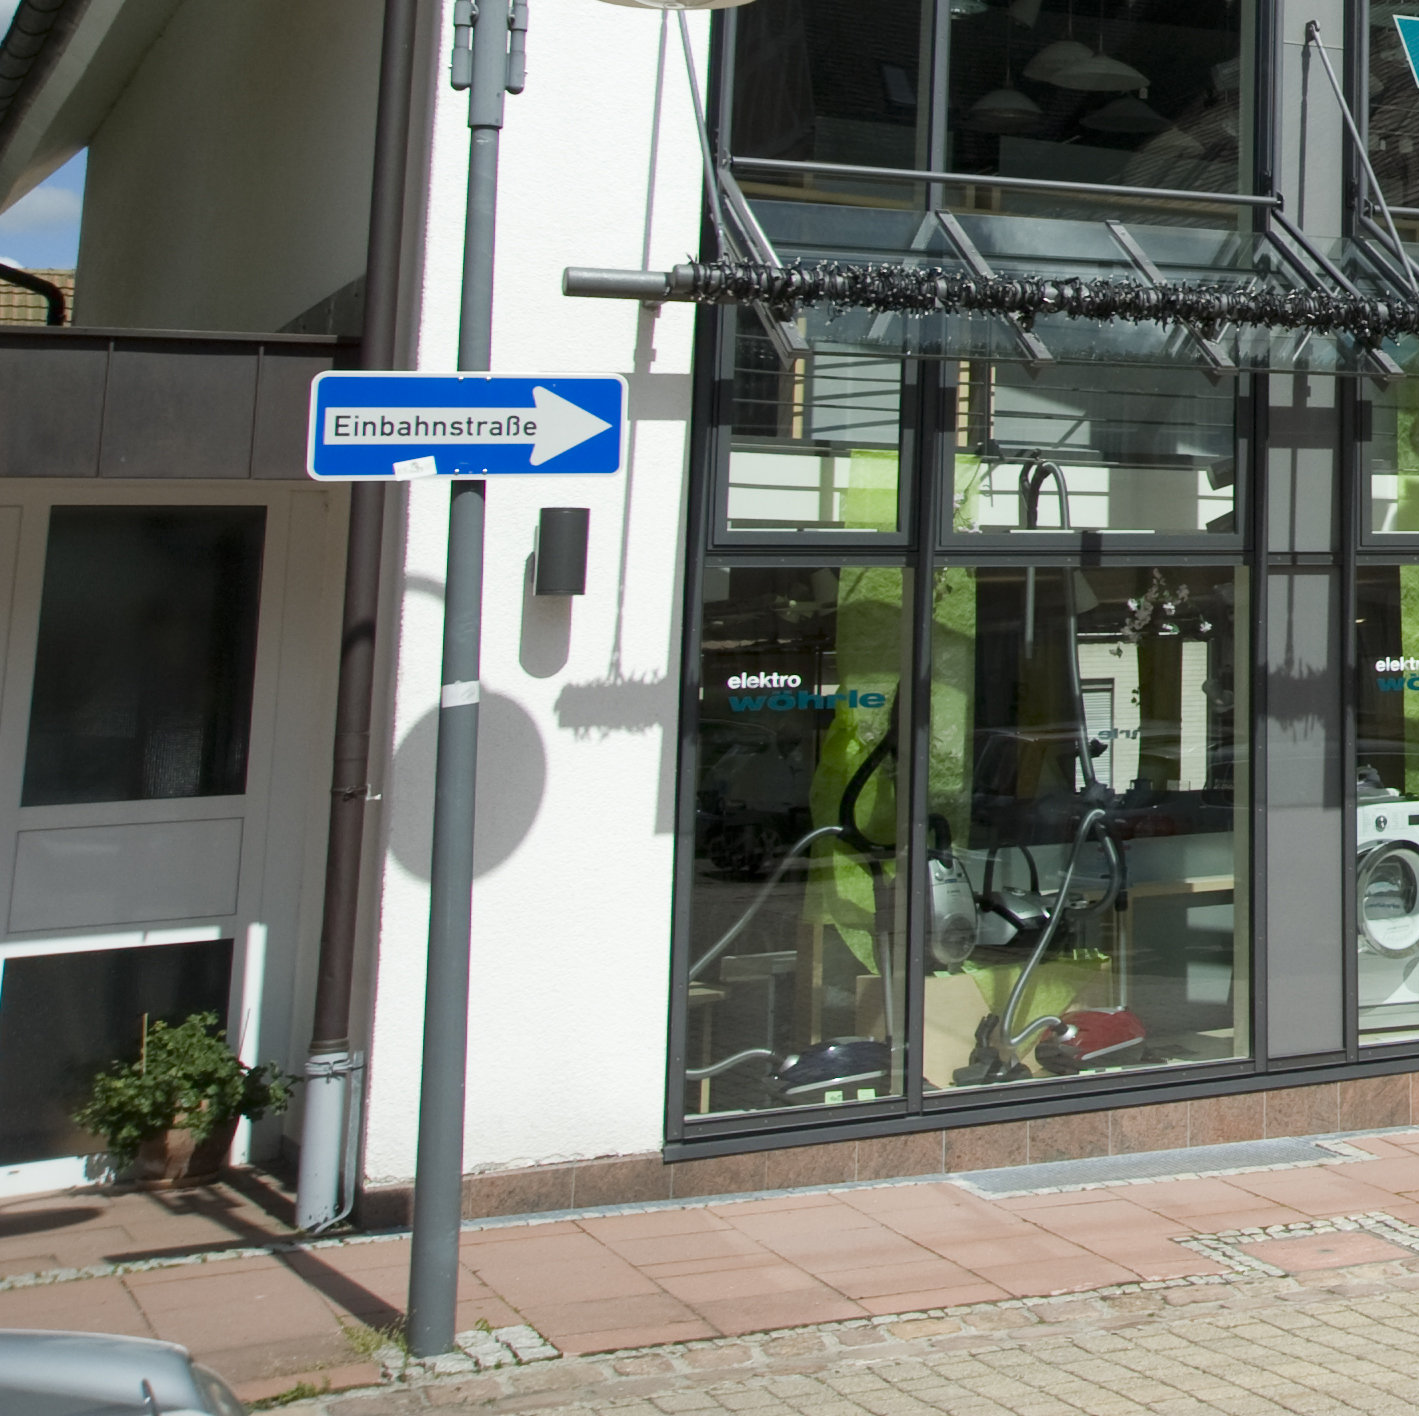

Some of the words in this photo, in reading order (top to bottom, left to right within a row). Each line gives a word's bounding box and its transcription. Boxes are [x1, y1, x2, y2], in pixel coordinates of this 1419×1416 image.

[334, 415, 537, 438] Einbahnstraße
[727, 671, 802, 689] elektro
[728, 689, 887, 712] wöhrle
